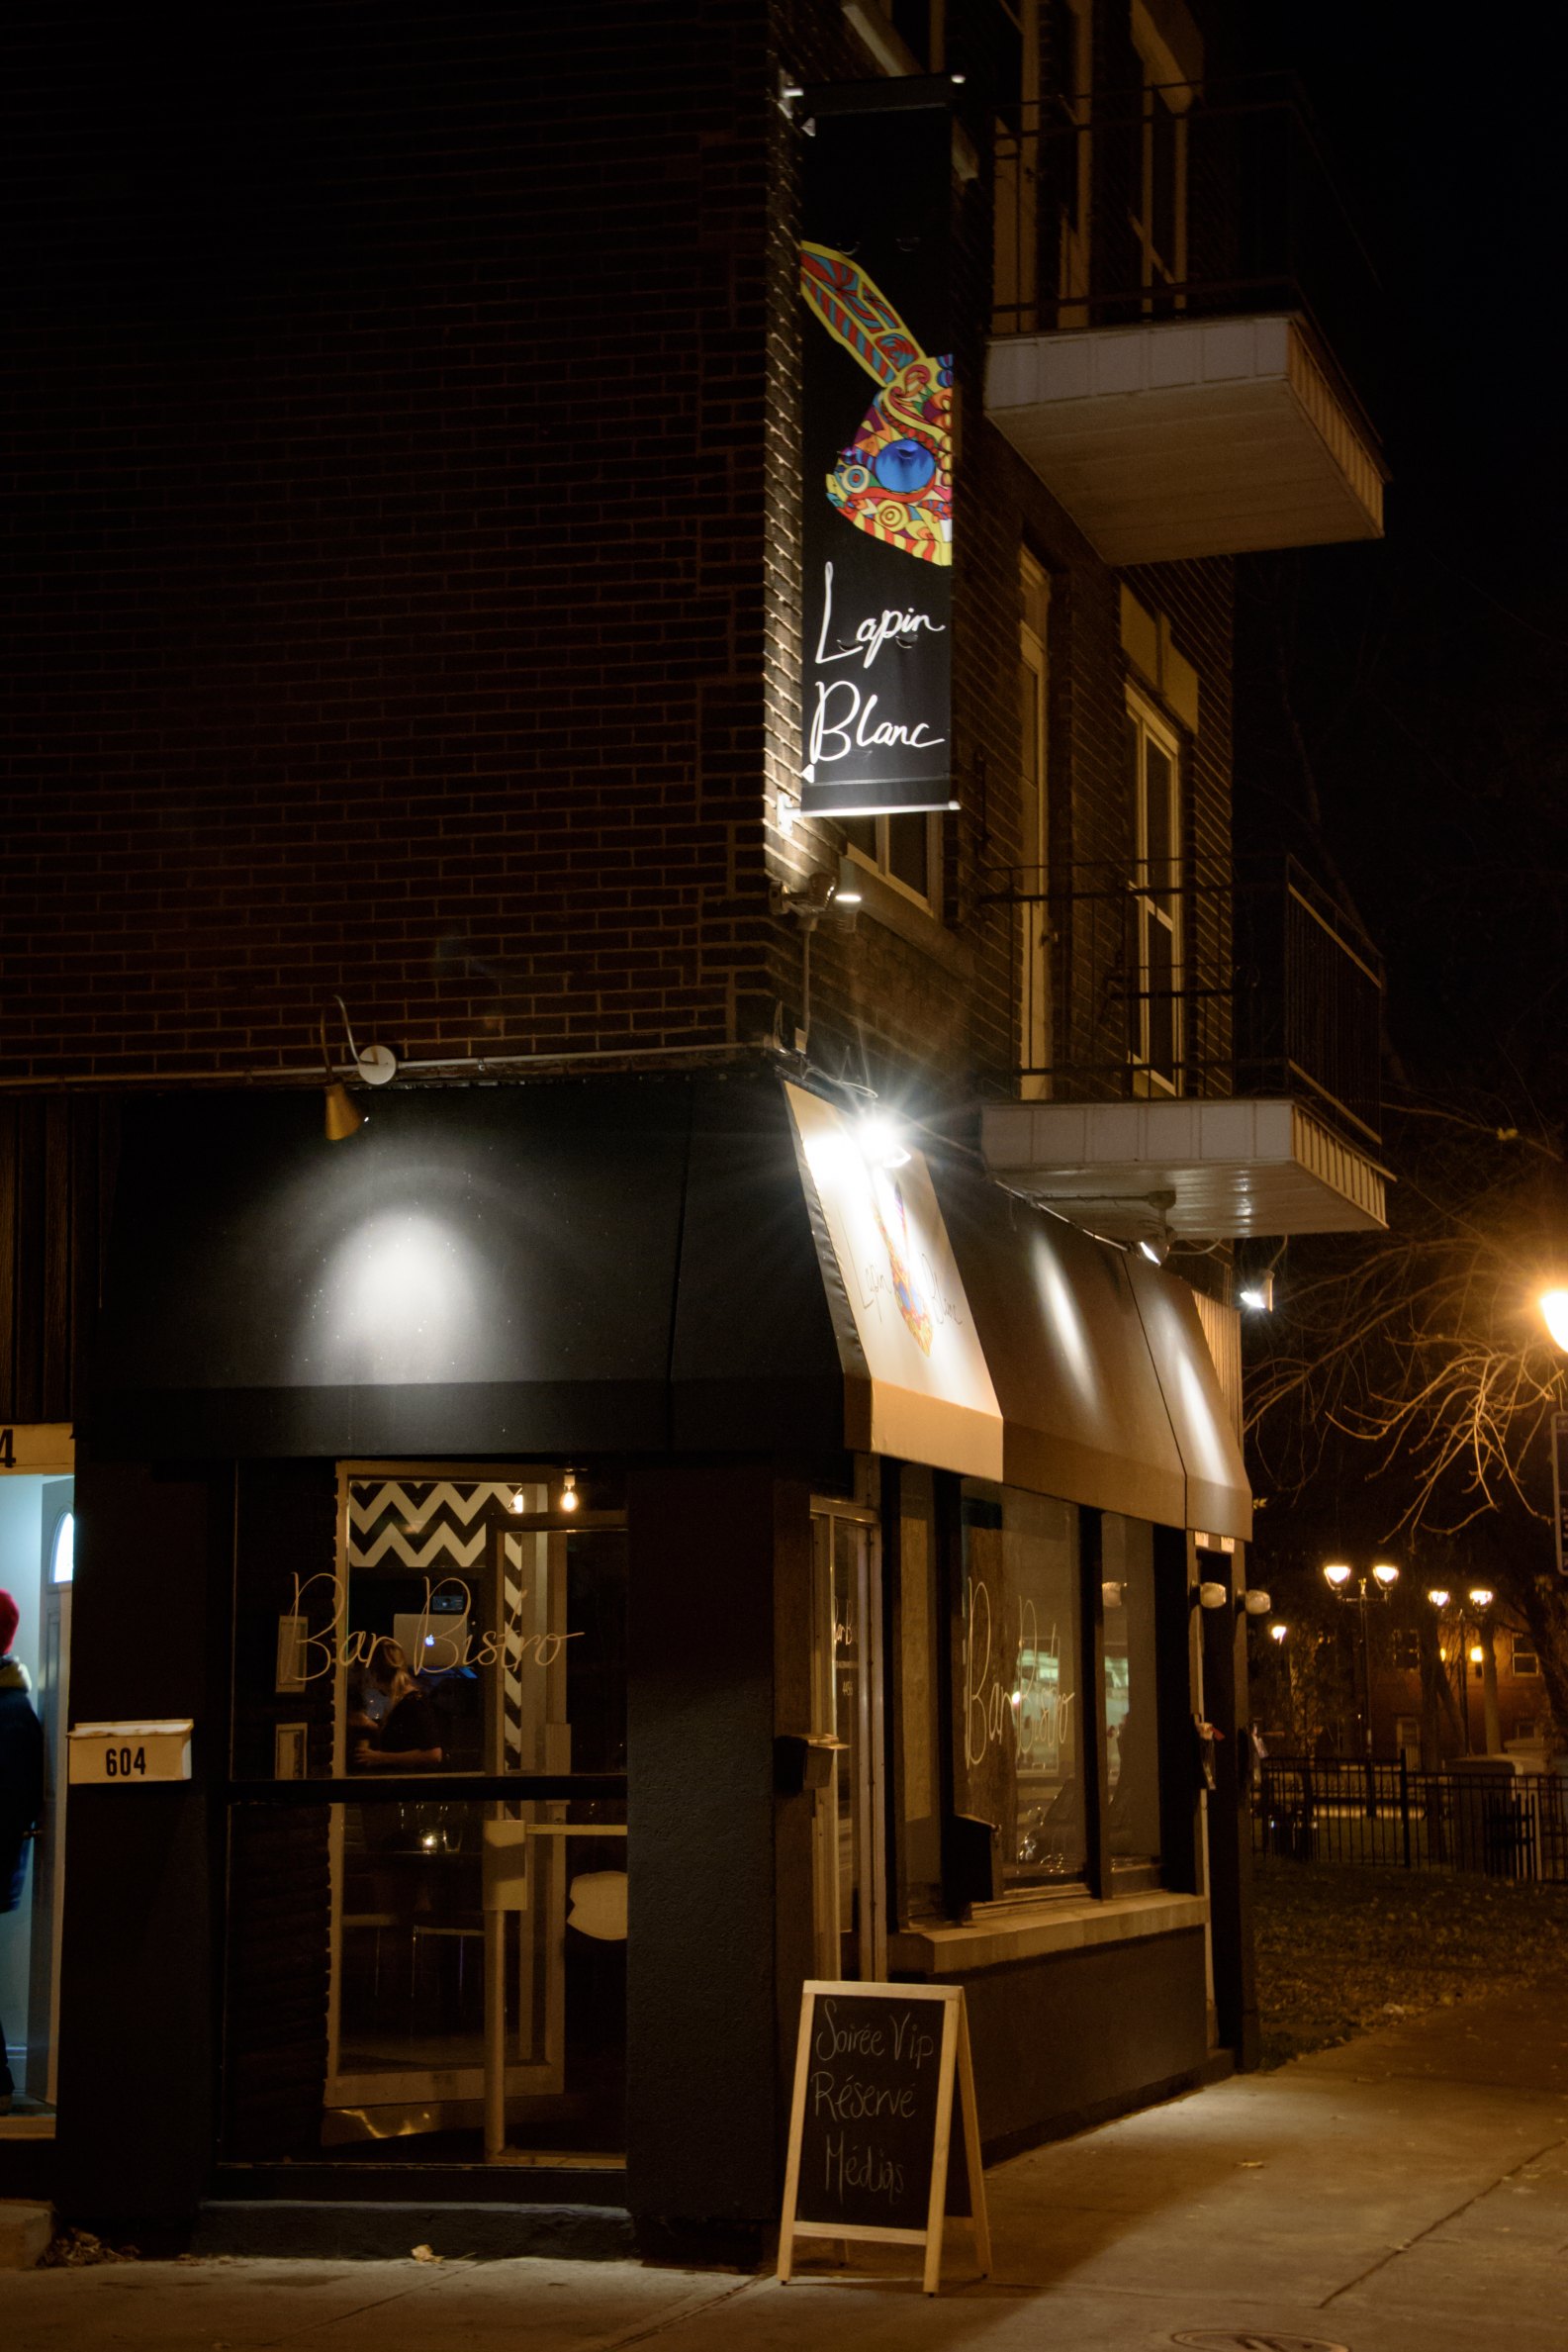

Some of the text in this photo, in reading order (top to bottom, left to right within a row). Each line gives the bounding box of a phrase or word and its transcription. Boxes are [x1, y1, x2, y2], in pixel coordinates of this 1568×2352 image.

[815, 561, 946, 669] Lapin
[809, 680, 946, 765] Blanc
[283, 1571, 586, 1681] Bar Bistro
[965, 1576, 1075, 1770] Bar Bistro
[106, 1746, 146, 1776] 604
[816, 1998, 935, 2070] Soirée Vip
